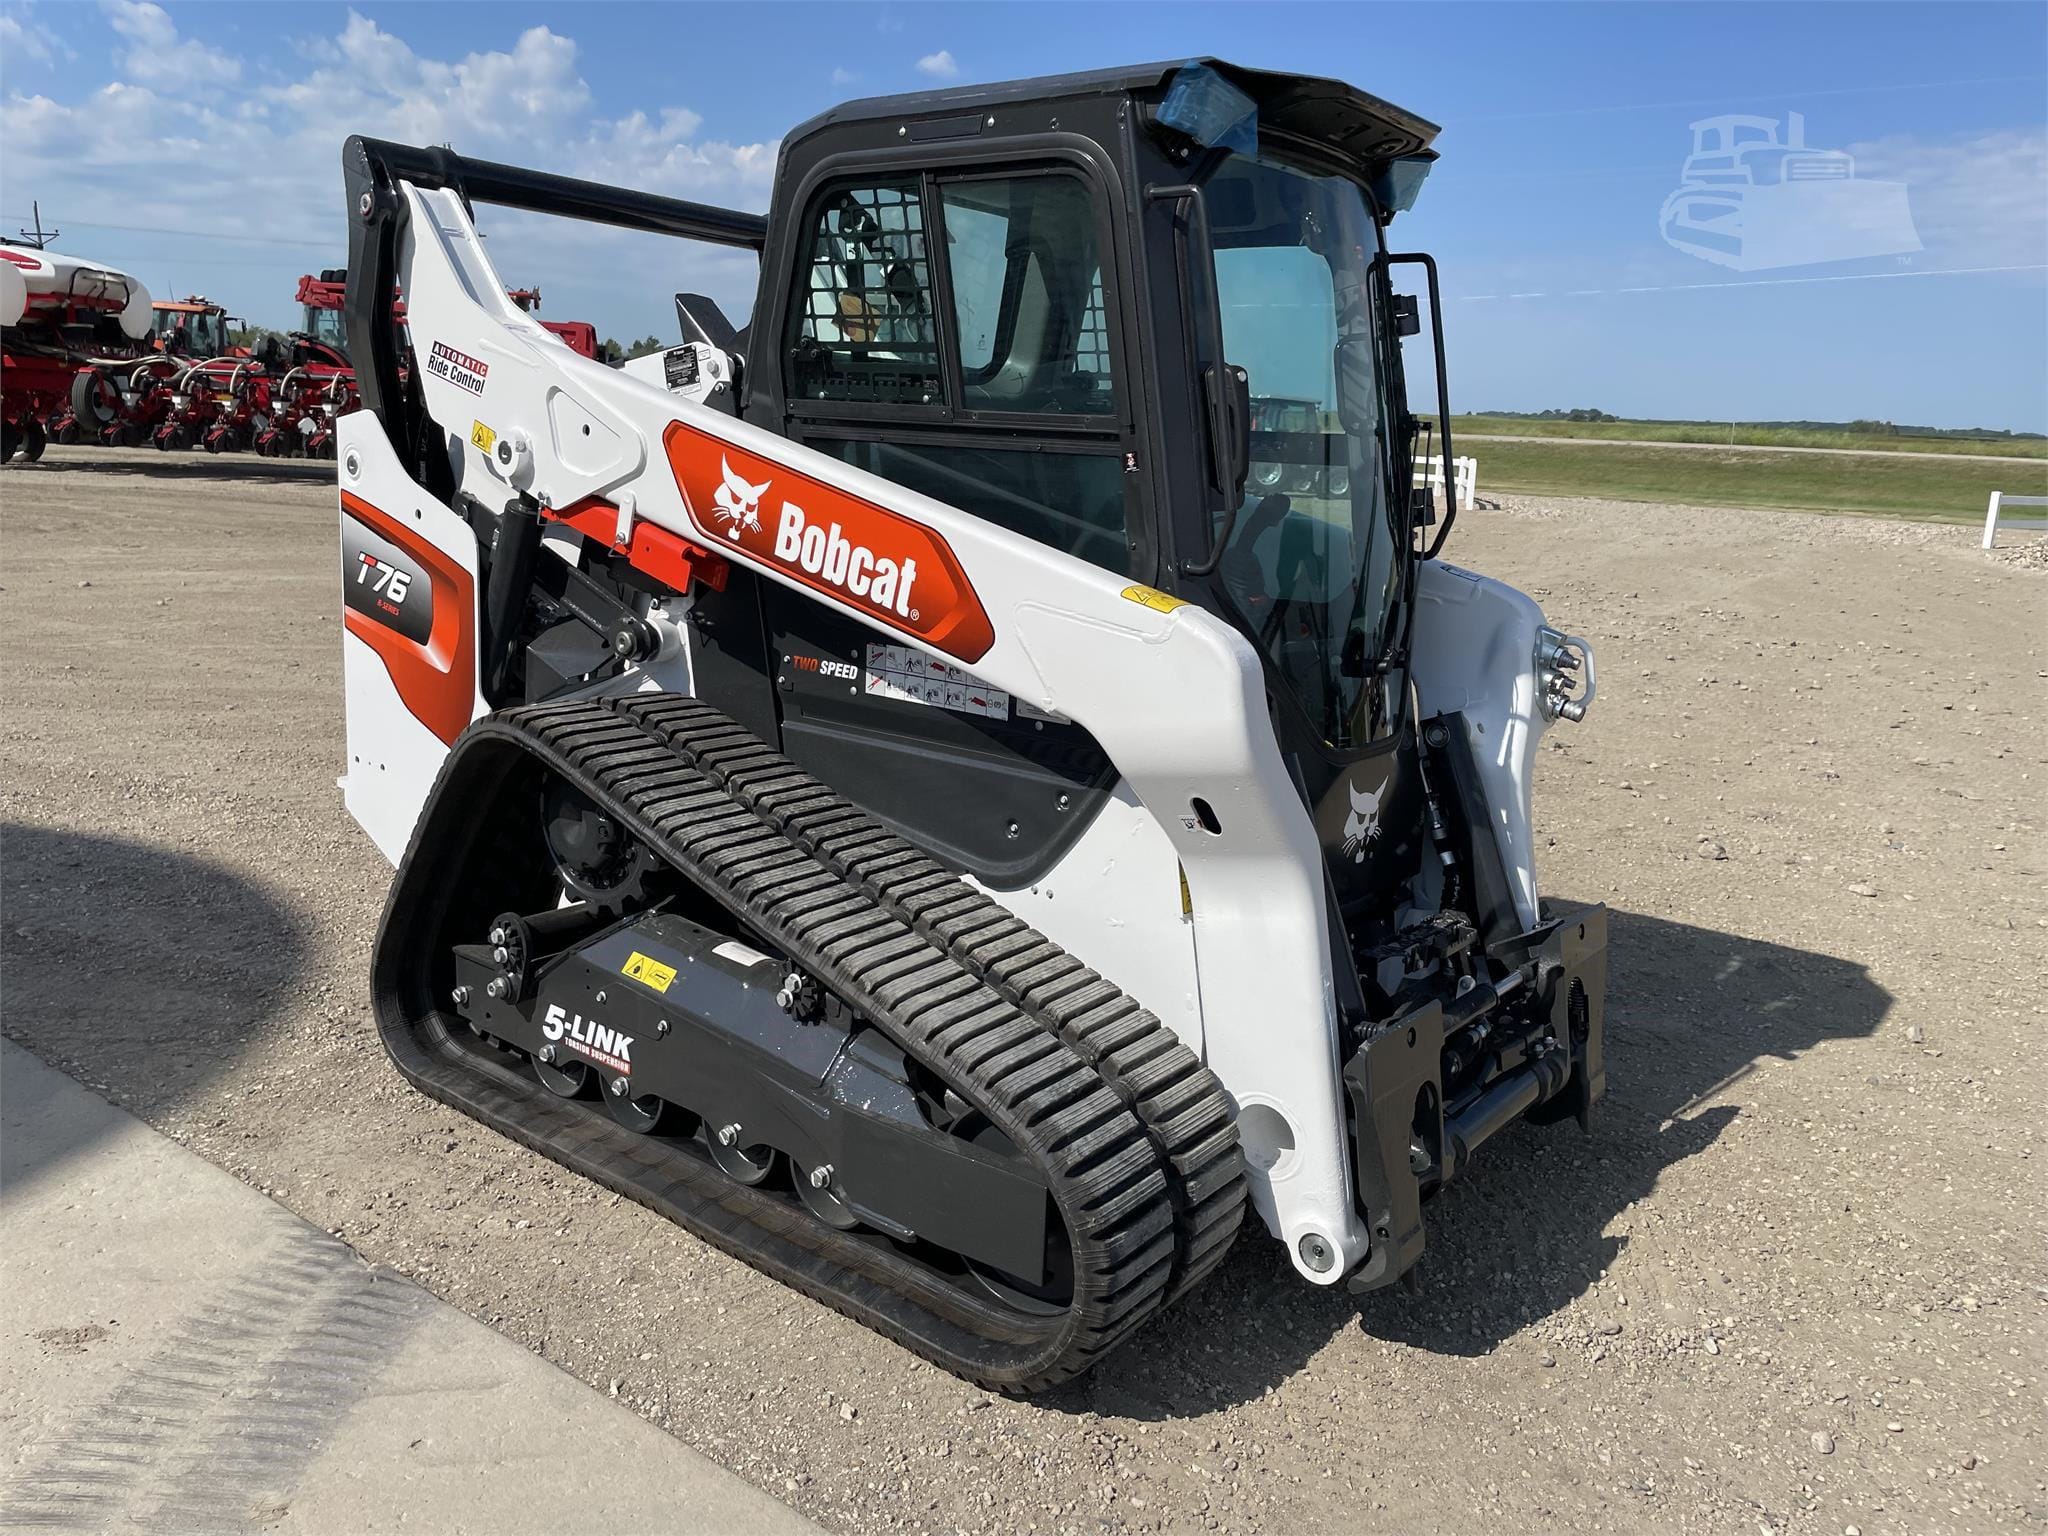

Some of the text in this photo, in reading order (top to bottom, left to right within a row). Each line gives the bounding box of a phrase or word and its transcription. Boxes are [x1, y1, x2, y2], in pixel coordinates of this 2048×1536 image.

[427, 354, 486, 394] Ride Control
[433, 343, 487, 375] AUTOMATIC
[357, 551, 413, 604] T76
[793, 655, 858, 680] TWO SPEED
[542, 1003, 635, 1062] 5-LINK
[564, 1036, 631, 1075] TORSION SUSPENSION
